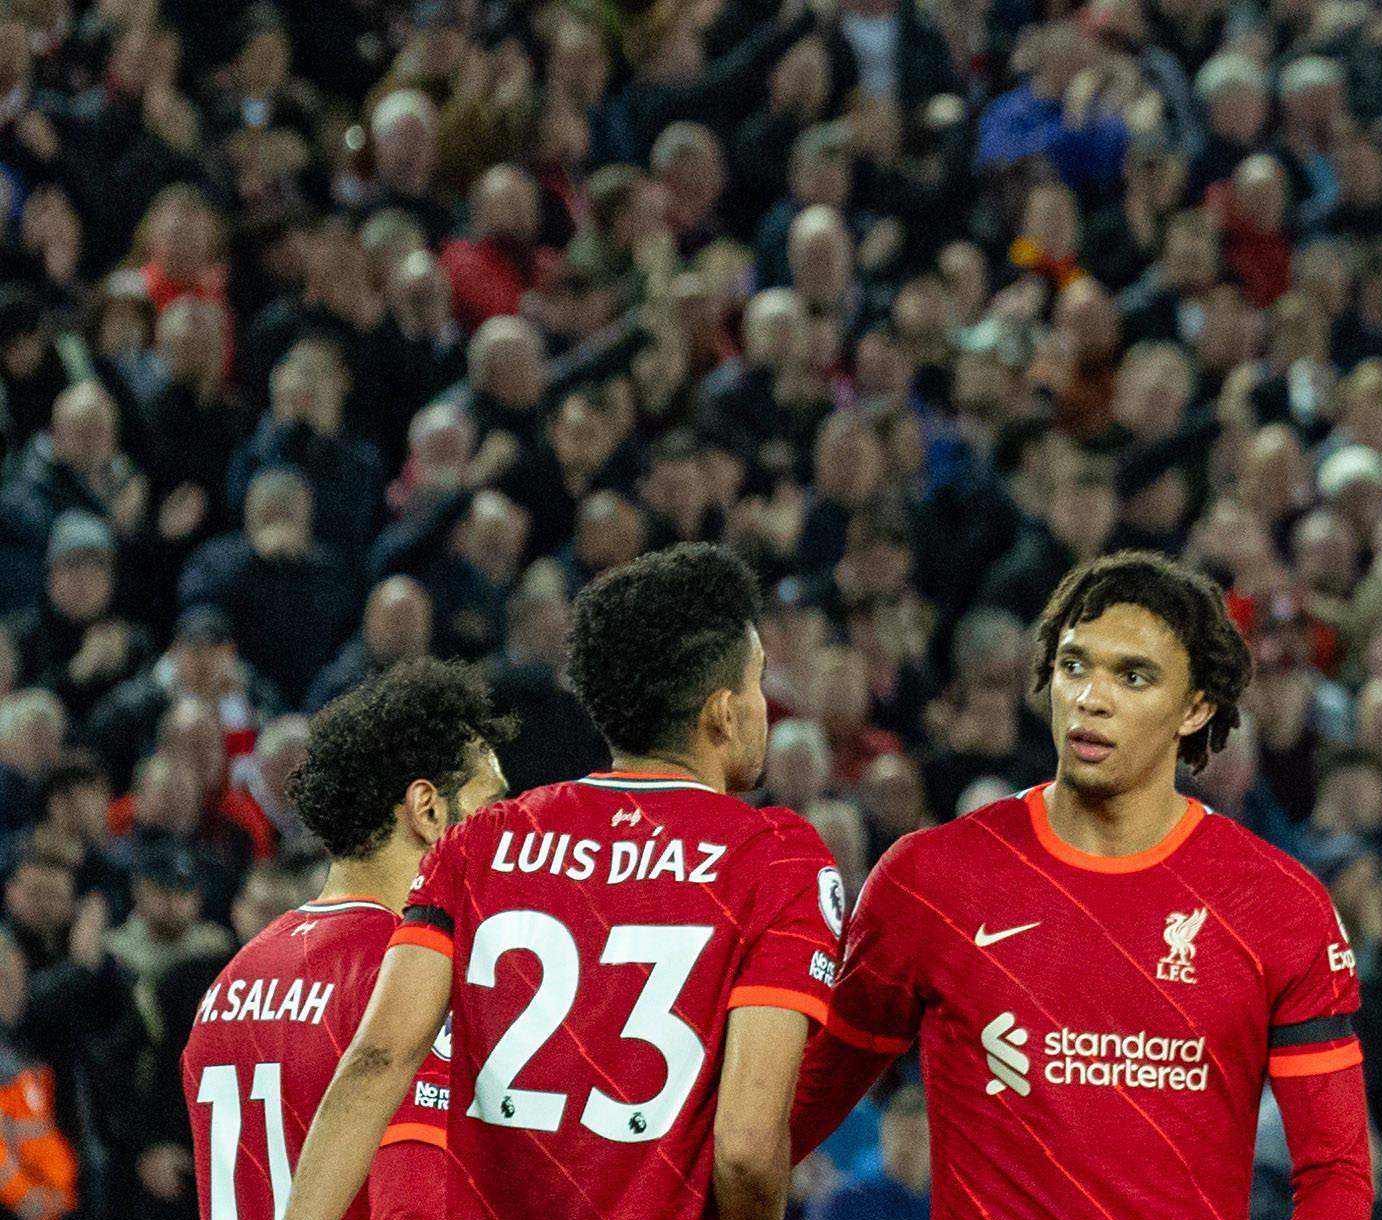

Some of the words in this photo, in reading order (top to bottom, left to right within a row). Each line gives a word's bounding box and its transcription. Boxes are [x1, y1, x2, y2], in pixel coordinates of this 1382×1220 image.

[491, 831, 600, 881] LUIS
[607, 826, 727, 885] DÍAZ
[220, 977, 335, 1025] SALAH
[466, 910, 715, 1143] 23
[1044, 1027, 1206, 1063] standard
[1044, 1056, 1209, 1092] chartered
